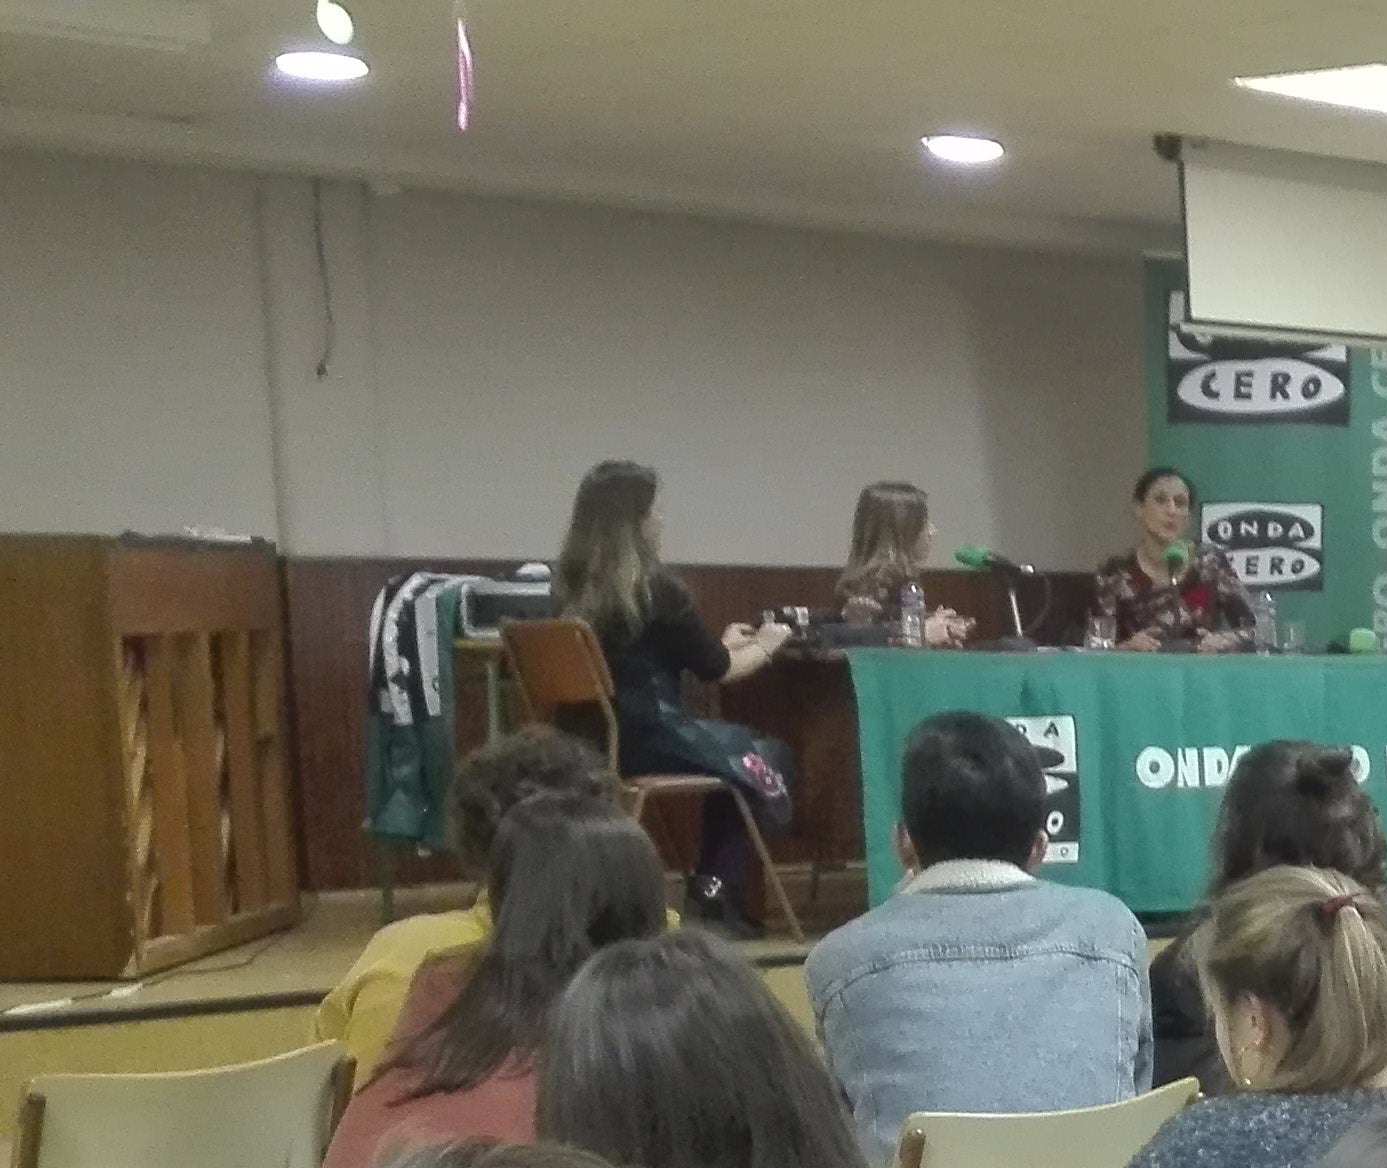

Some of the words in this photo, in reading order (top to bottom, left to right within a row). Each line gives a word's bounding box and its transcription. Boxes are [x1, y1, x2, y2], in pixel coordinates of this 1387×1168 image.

[1200, 369, 1322, 401] CERO
[1217, 518, 1305, 541] ONDA
[1244, 554, 1305, 576] ERO
